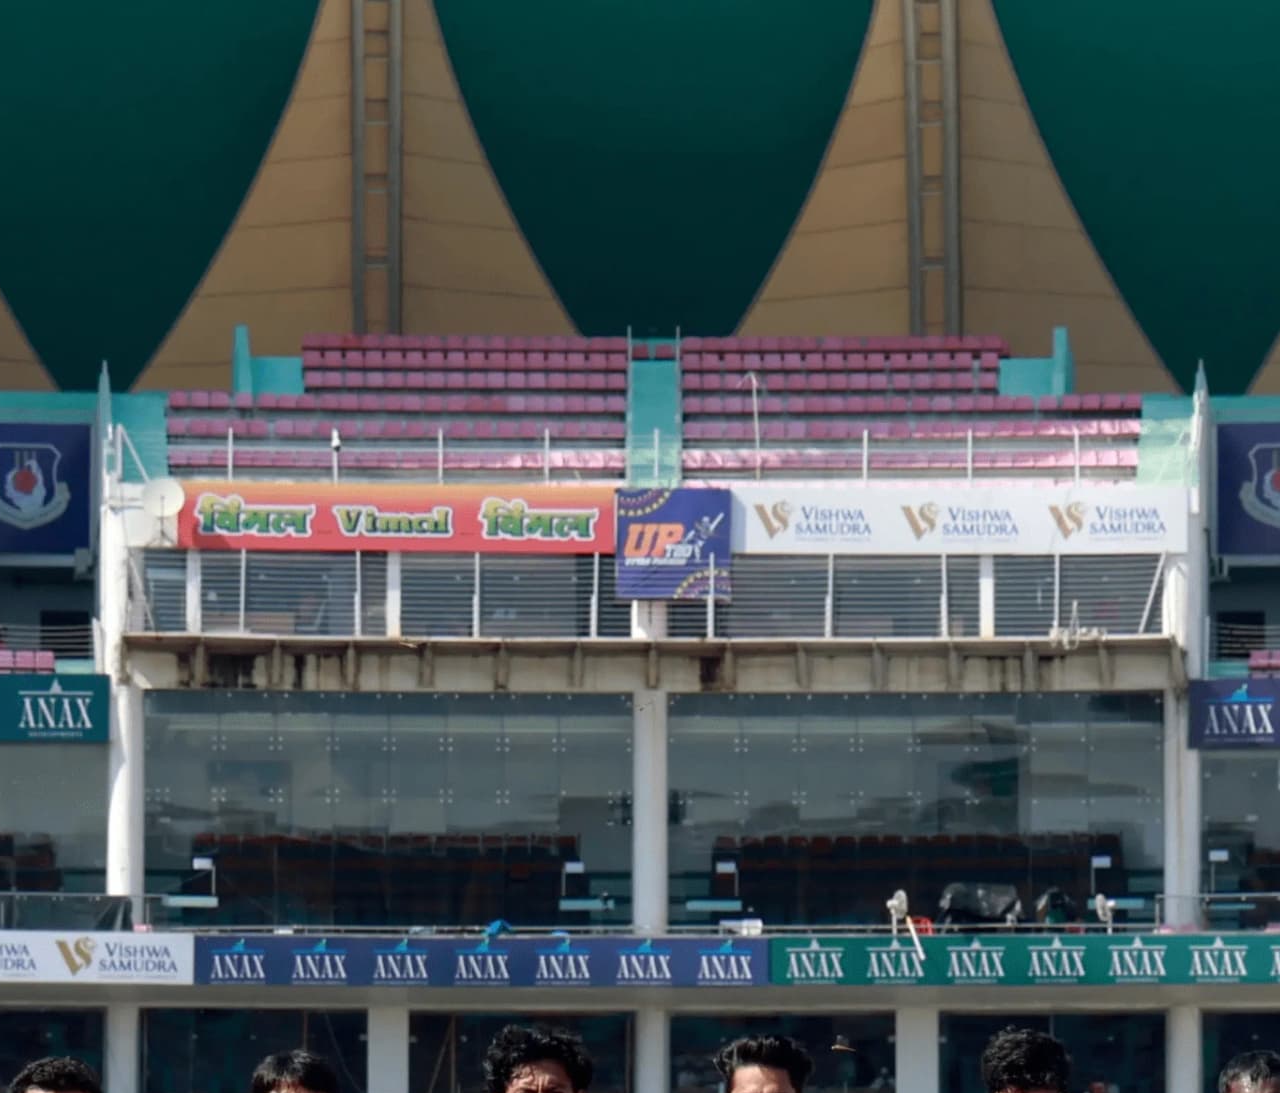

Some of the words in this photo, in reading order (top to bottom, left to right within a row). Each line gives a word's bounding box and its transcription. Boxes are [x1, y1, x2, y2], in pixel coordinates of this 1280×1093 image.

[624, 523, 685, 558] UP
[795, 524, 872, 536] SAMUDRA
[942, 524, 1019, 537] SAMUDRA
[1089, 522, 1167, 535] SAMUDRA
[18, 697, 93, 729] ANAX
[1204, 704, 1274, 735] ANAX
[98, 960, 178, 973] SAMUDRA
[210, 954, 265, 979] ANAX
[292, 954, 347, 979] ANAX
[373, 954, 428, 979] ANAX
[454, 954, 510, 980] ANAX
[535, 955, 591, 980] ANAX
[616, 955, 672, 980] ANAX
[697, 955, 752, 980] ANAX
[786, 952, 844, 978] ANAX
[867, 952, 925, 978] ANAX
[947, 952, 1005, 978] ANAX
[1028, 951, 1086, 977] ANAX
[1109, 950, 1167, 976] ANAX
[1189, 950, 1248, 976] ANAX
